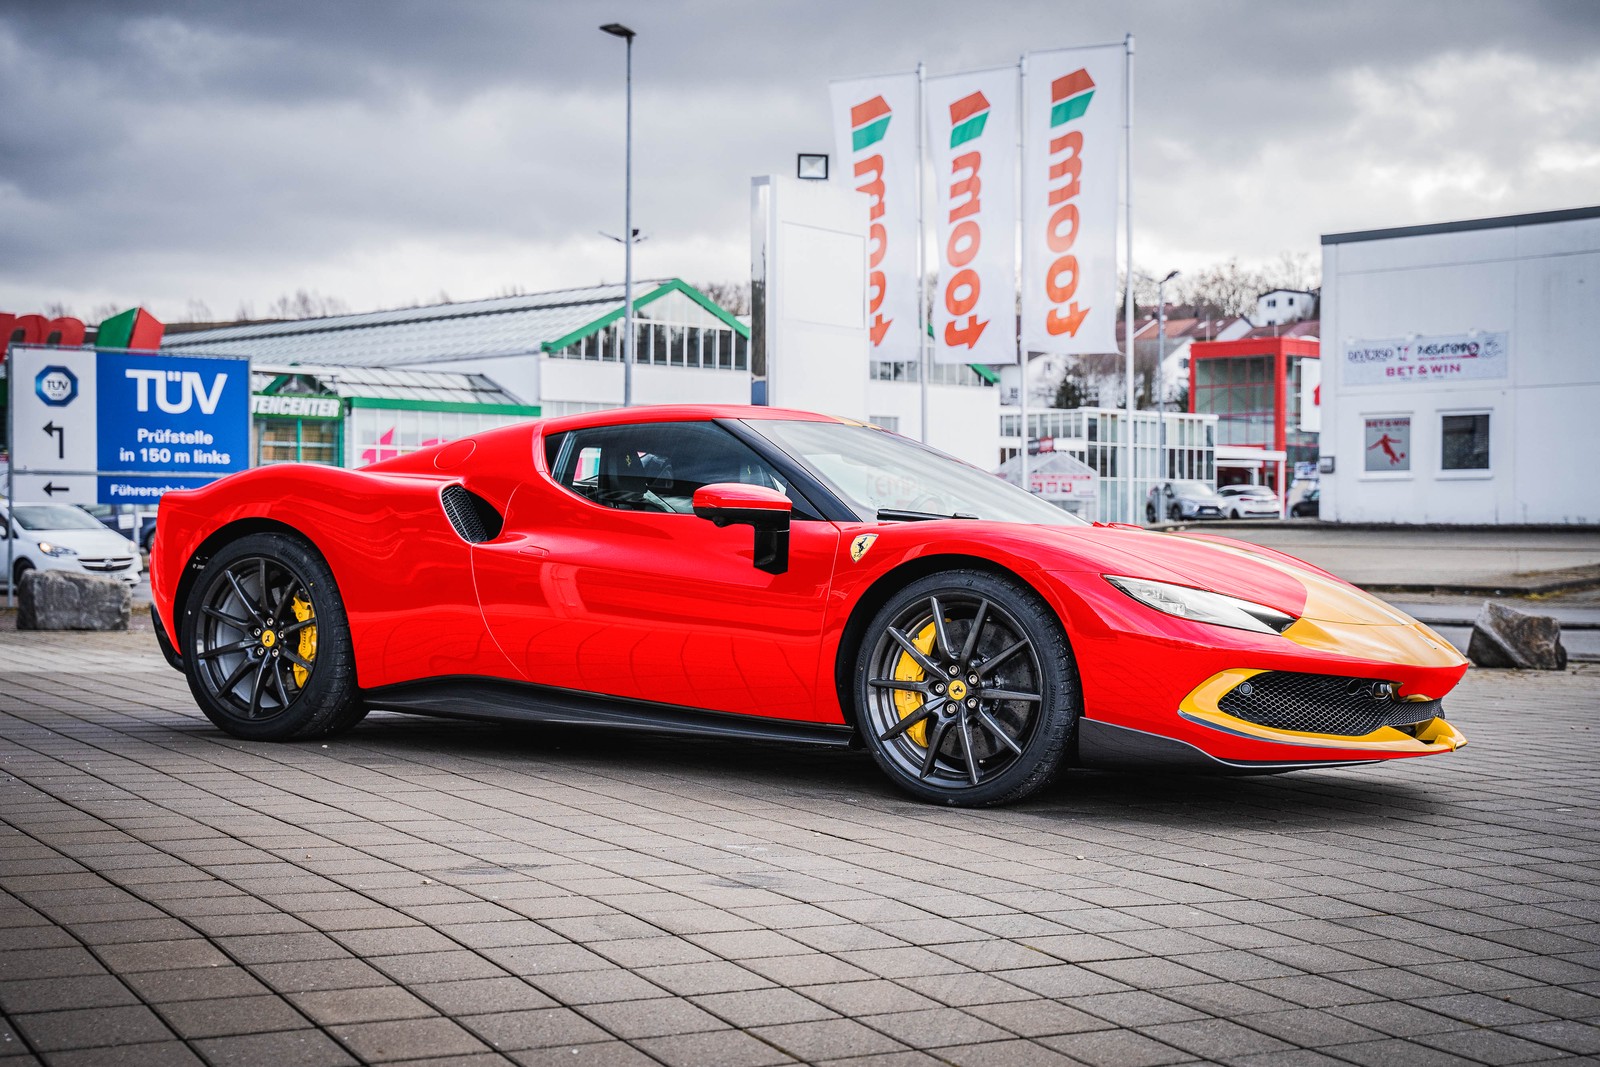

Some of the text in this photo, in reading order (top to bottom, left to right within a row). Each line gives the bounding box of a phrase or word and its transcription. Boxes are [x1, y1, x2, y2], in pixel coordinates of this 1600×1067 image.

[944, 150, 990, 350] toom
[1046, 130, 1091, 338] toom
[125, 368, 228, 415] TÜV
[119, 447, 231, 465] in 150 m links
[137, 428, 214, 445] Prüfstelle
[1042, 684, 1056, 736] BRIDGESTONE
